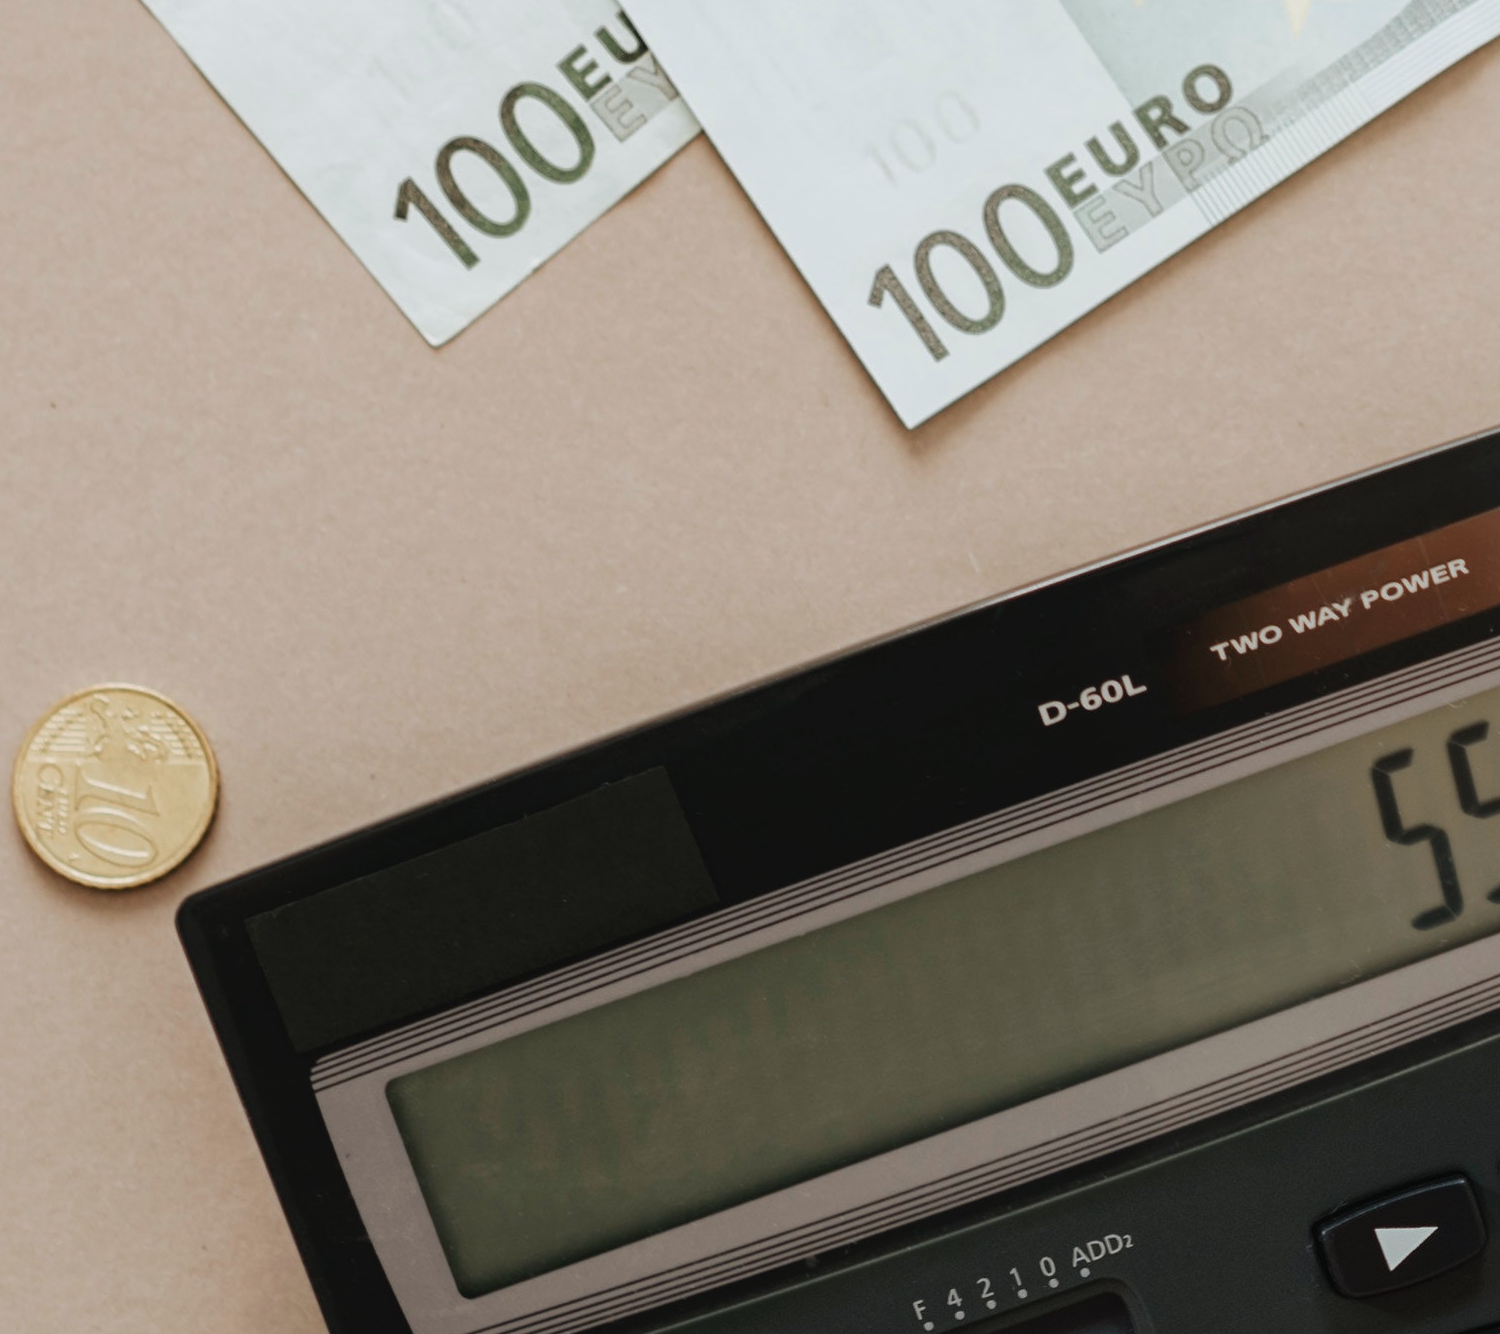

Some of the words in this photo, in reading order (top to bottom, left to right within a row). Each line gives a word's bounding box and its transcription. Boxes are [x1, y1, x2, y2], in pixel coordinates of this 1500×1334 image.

[393, 81, 597, 271] 100
[556, 9, 649, 102] EU
[866, 182, 1076, 364] 100
[1043, 63, 1233, 207] EURO
[1209, 625, 1283, 661] TWO
[1287, 597, 1352, 634] WAY
[1360, 558, 1470, 610] POWER
[1037, 674, 1148, 726] D-60L
[37, 764, 62, 838] CENT
[71, 765, 160, 867] 10
[912, 1299, 927, 1321] F
[947, 1288, 963, 1307] 4
[976, 1277, 995, 1299] 2
[1009, 1267, 1022, 1287] 1
[1039, 1256, 1056, 1277] 0
